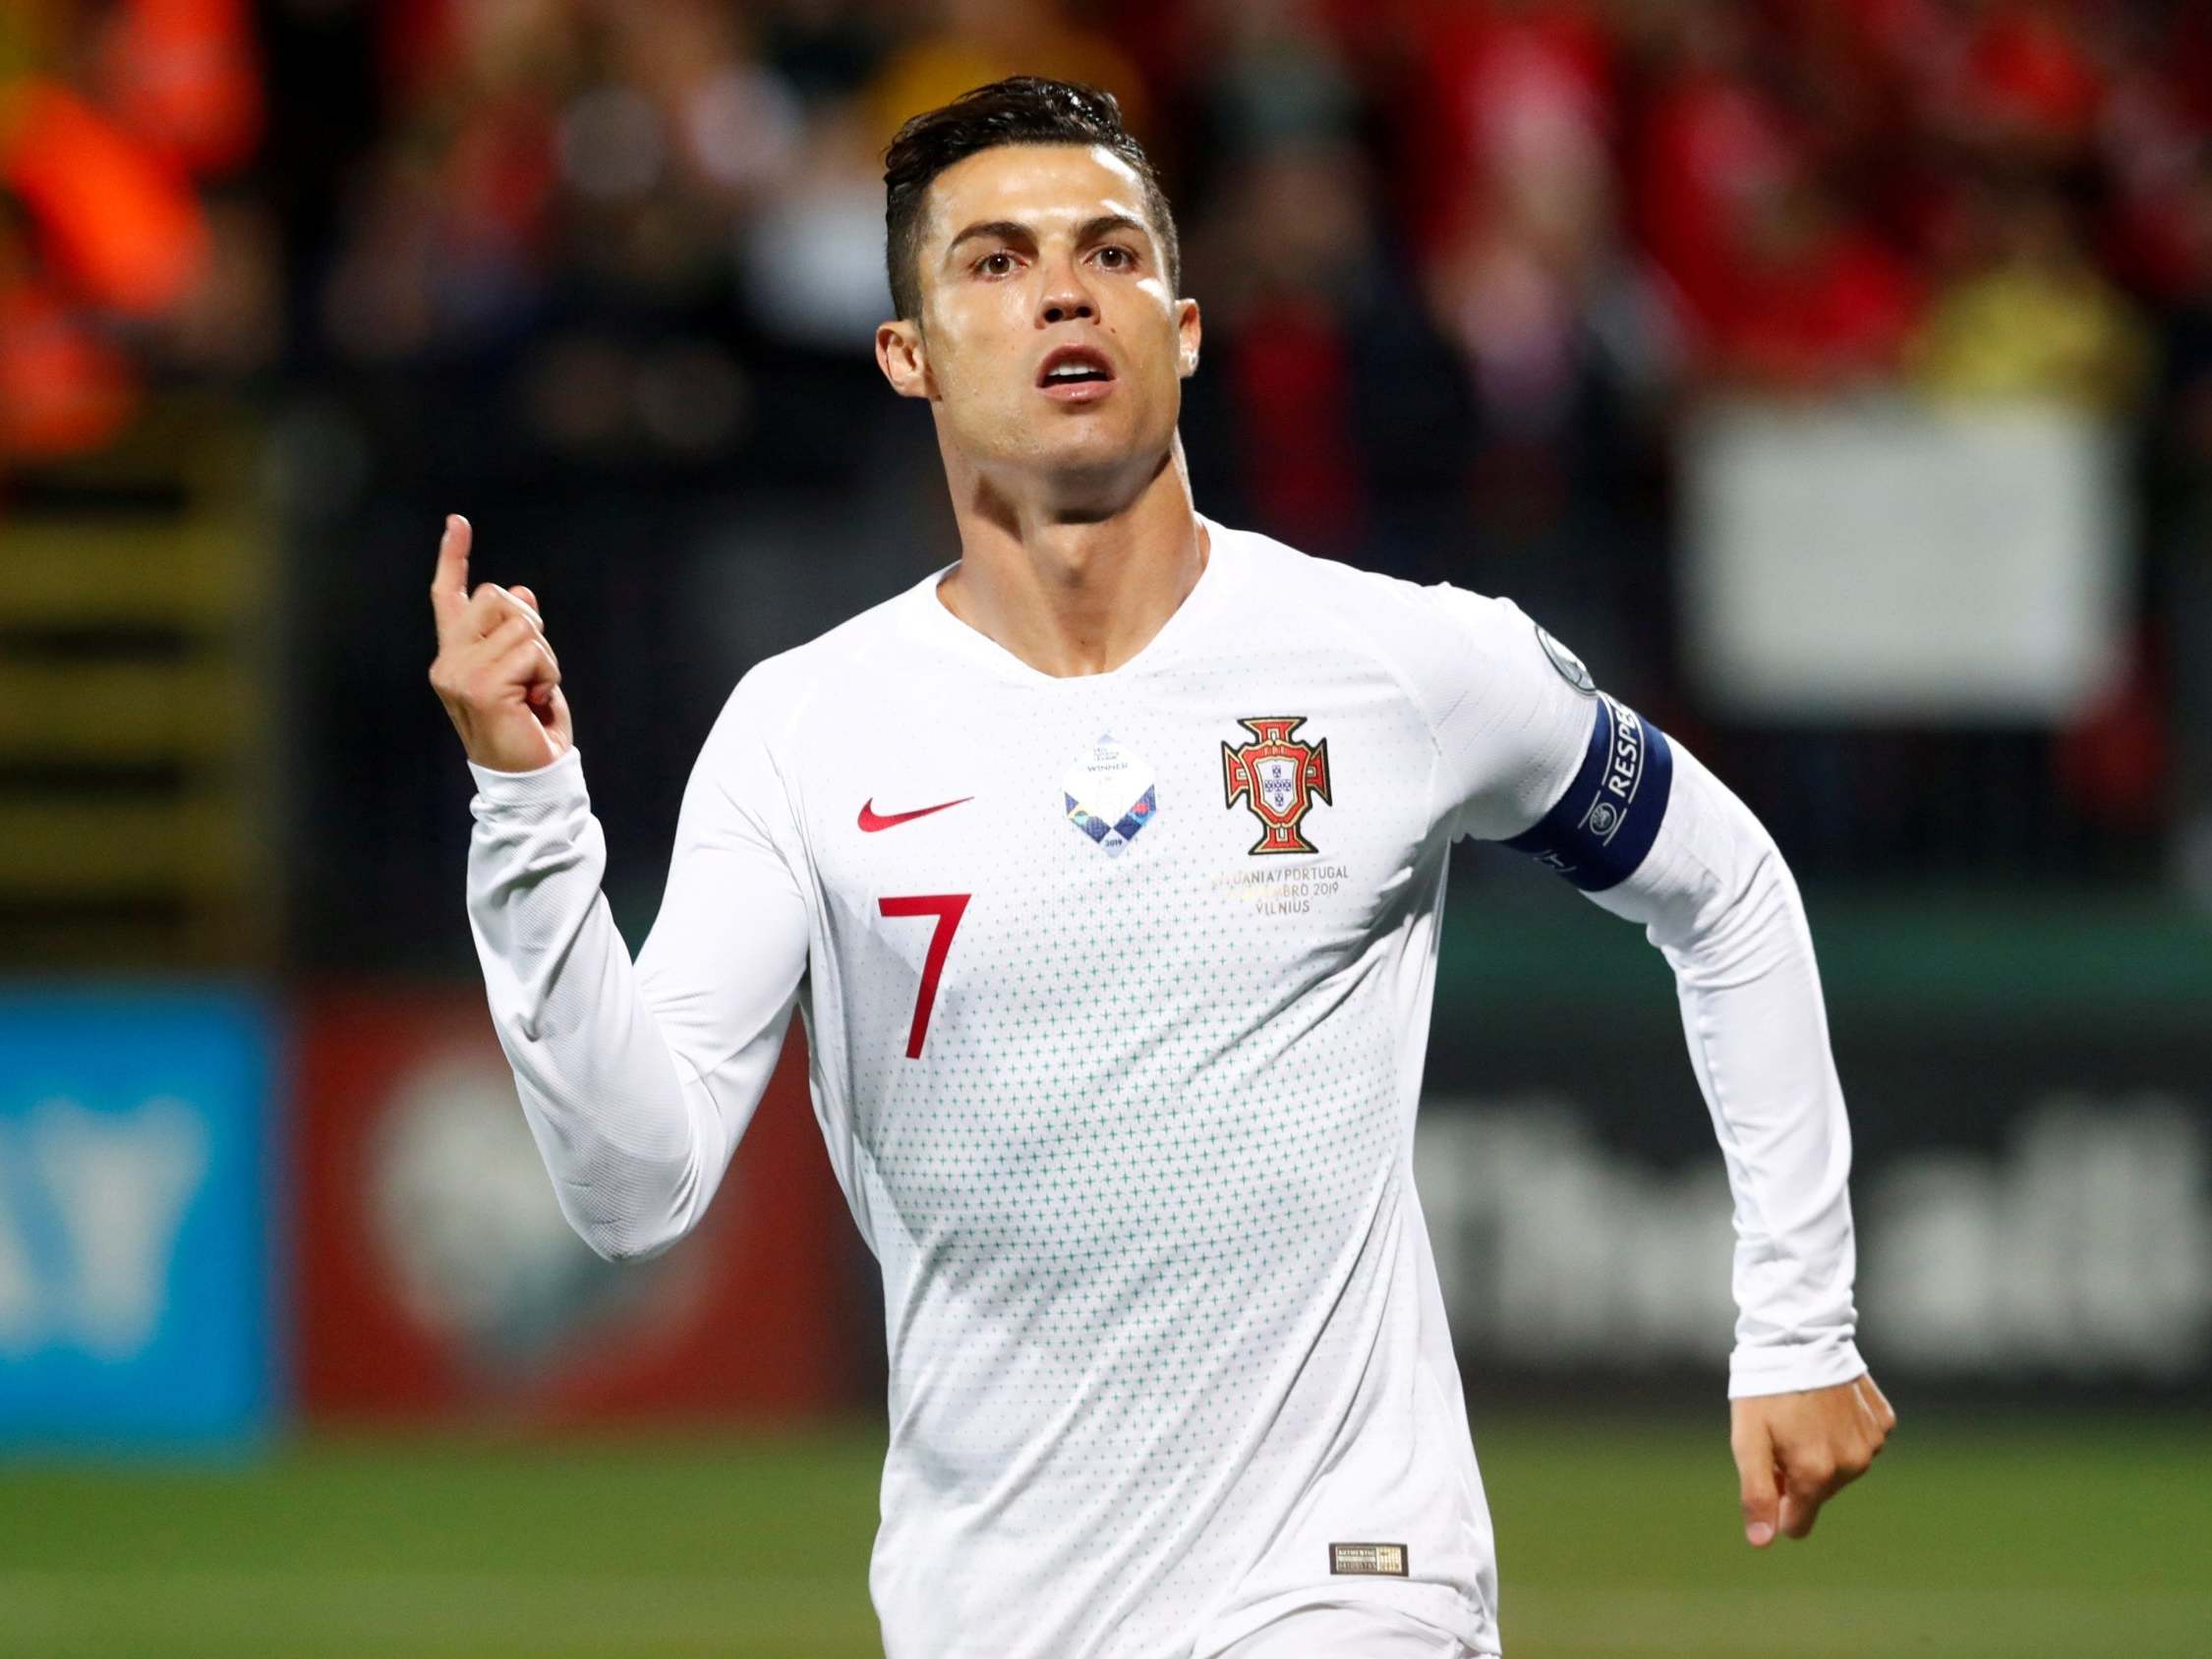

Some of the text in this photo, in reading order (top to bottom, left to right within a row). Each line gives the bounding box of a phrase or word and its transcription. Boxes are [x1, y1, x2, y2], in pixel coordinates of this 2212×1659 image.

[1312, 881, 1339, 896] 2019
[1255, 899, 1310, 916] VILNIUS
[878, 893, 972, 1059] 7
